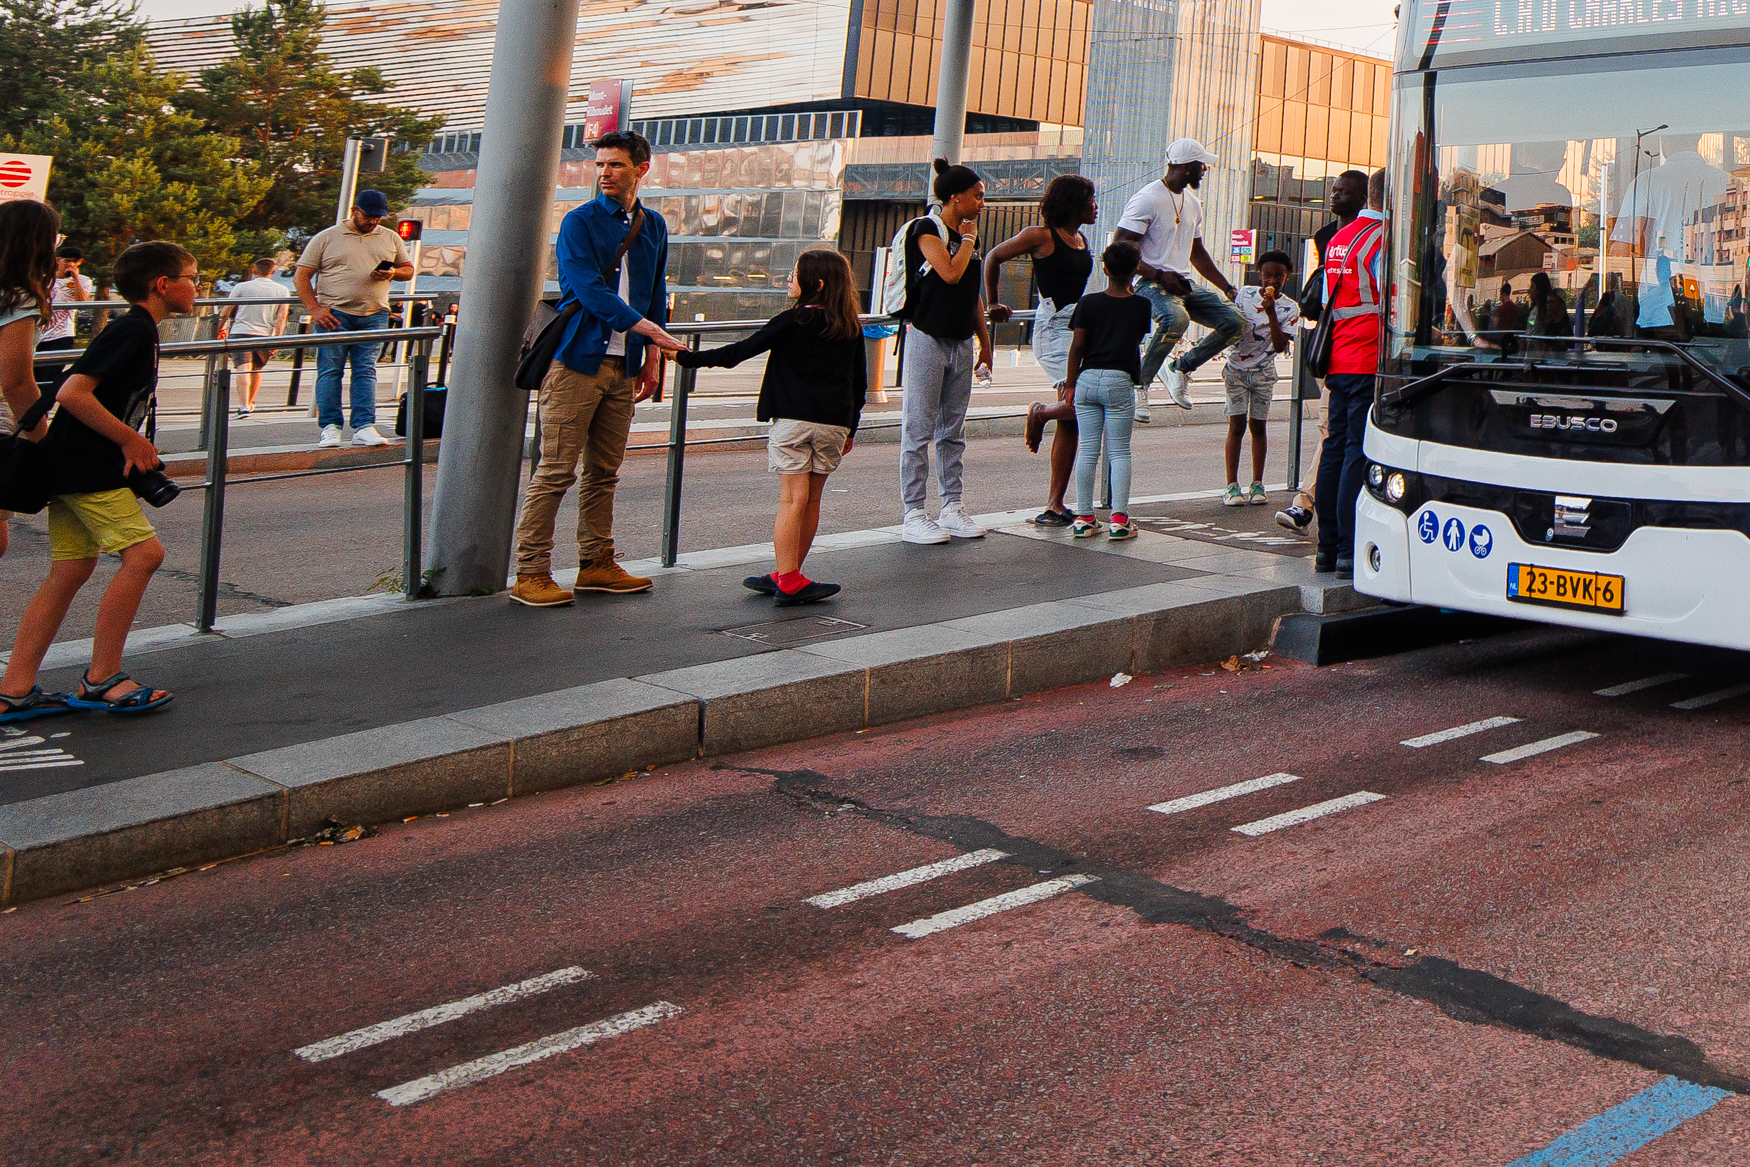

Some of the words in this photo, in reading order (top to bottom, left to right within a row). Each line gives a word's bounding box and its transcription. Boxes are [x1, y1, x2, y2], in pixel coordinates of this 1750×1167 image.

[1530, 414, 1618, 433] EBUSCO
[1509, 582, 1518, 590] NL
[1525, 570, 1614, 603] 23-BVK-6
